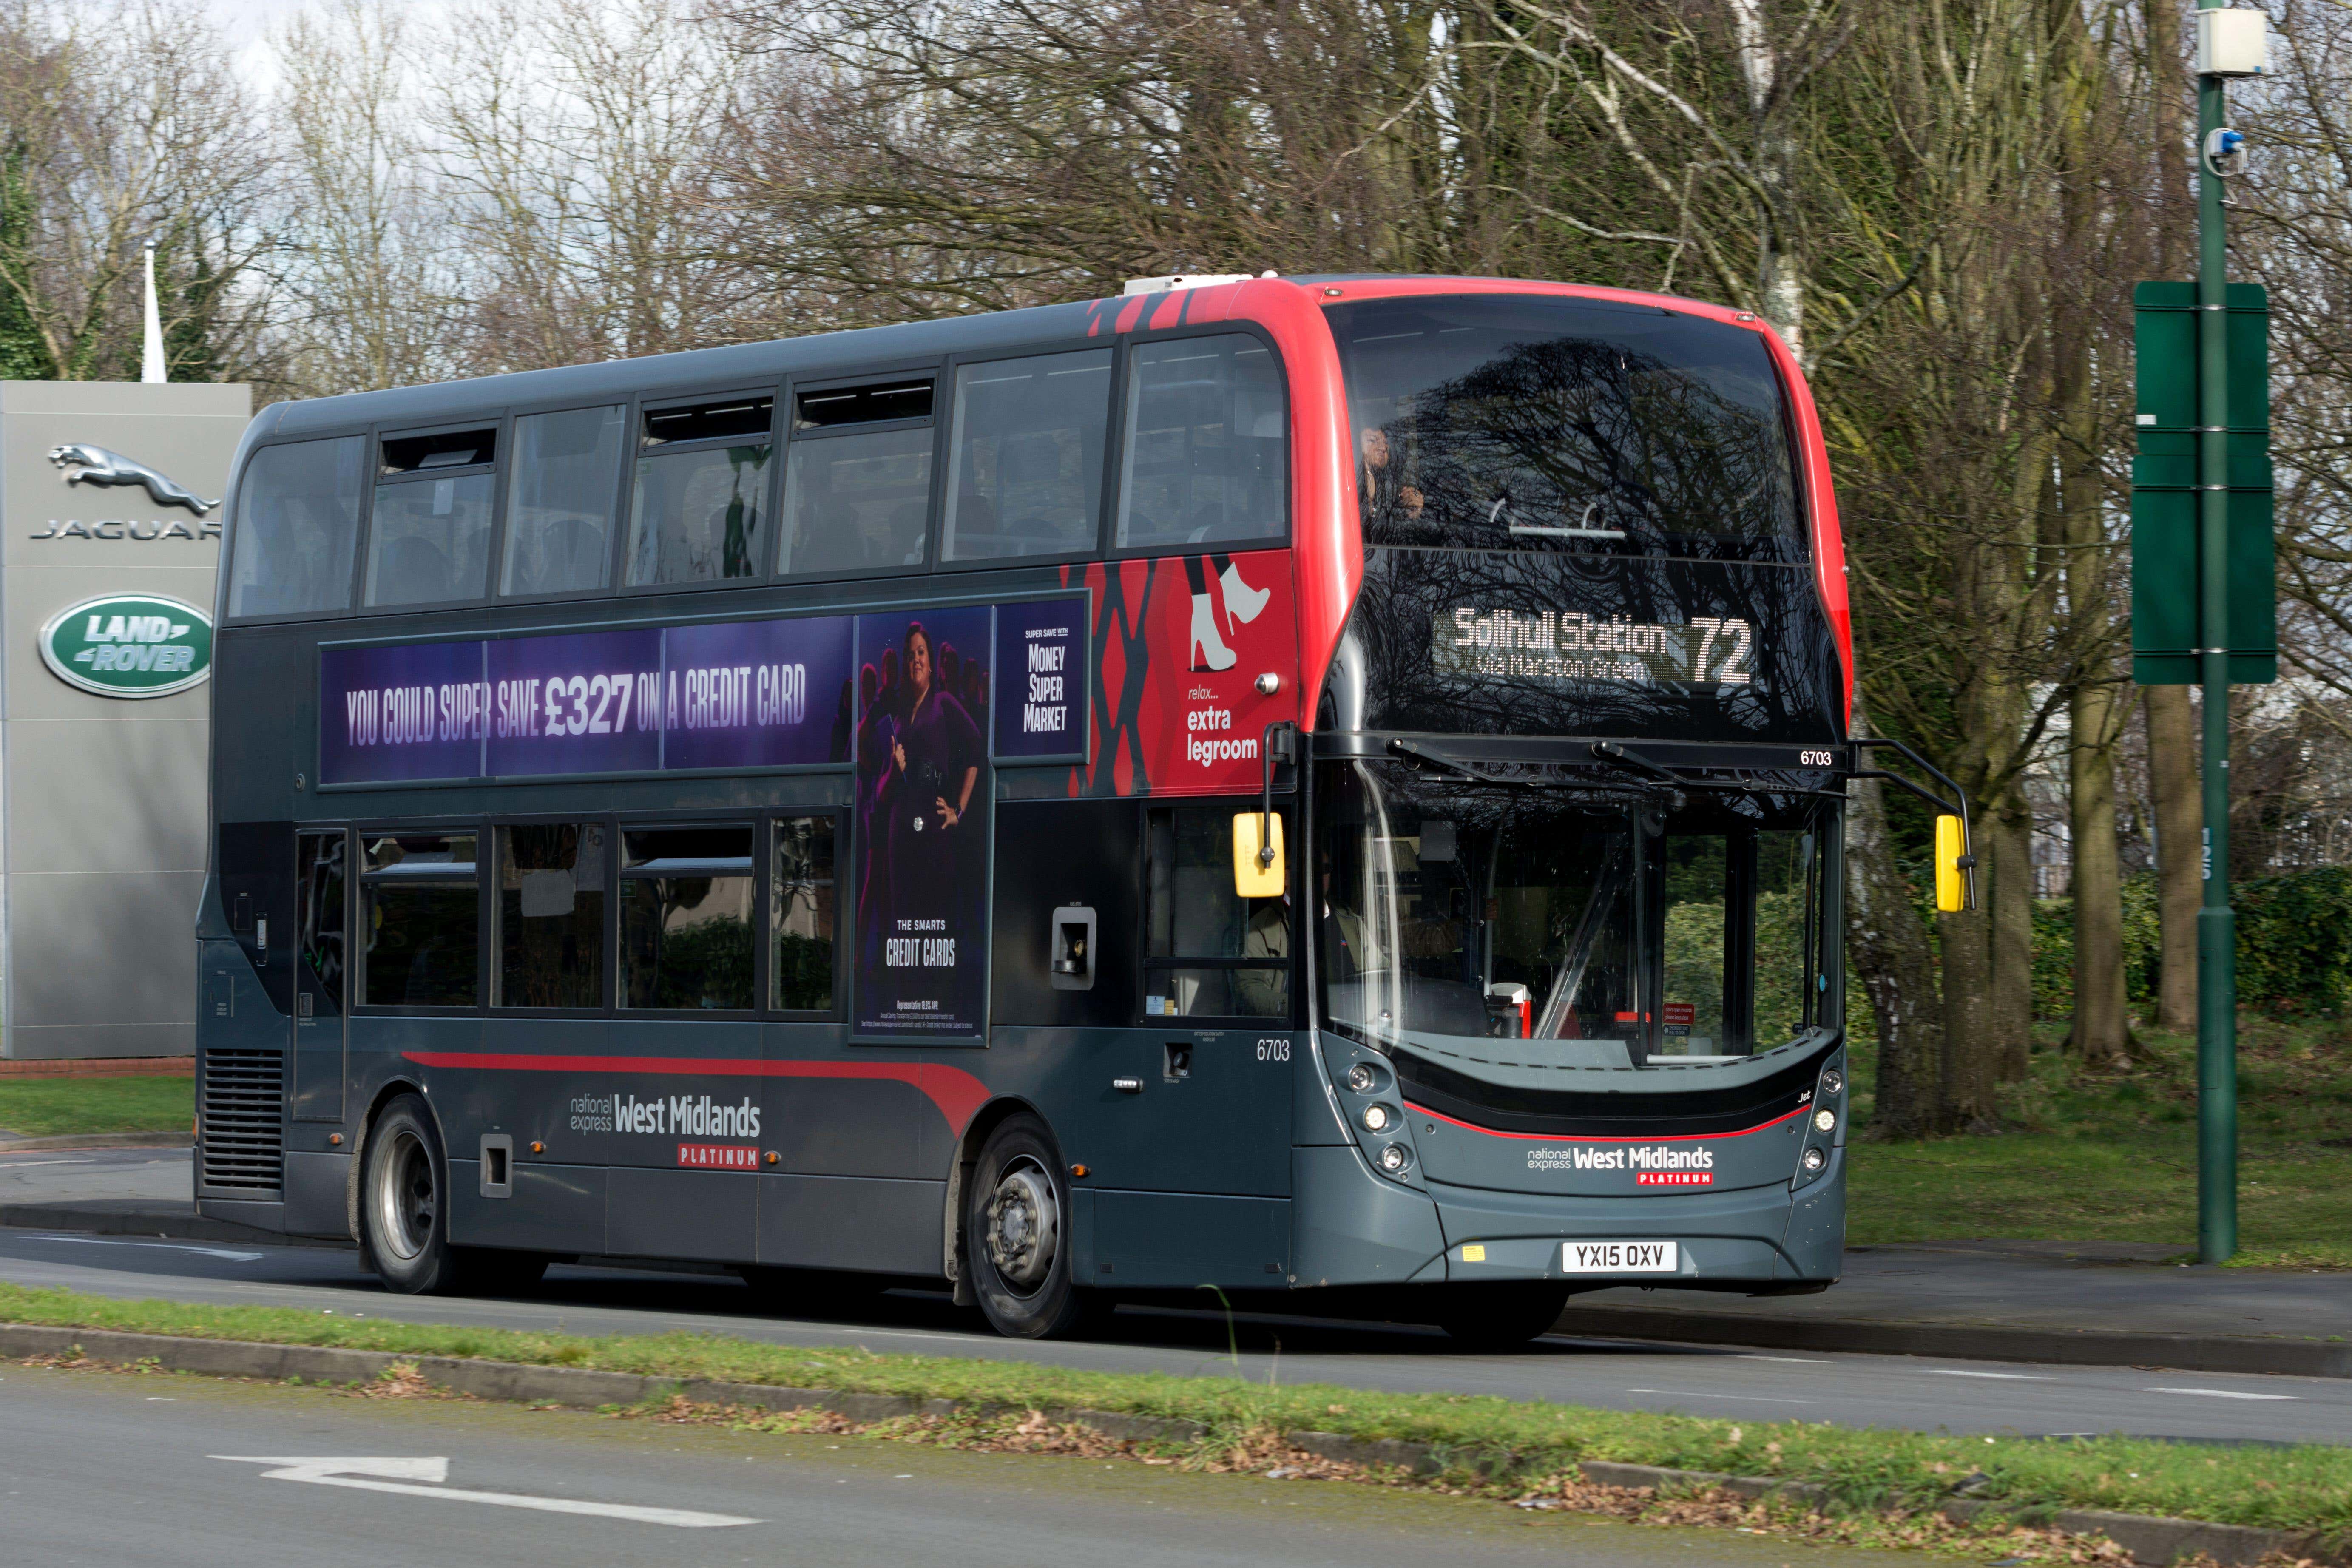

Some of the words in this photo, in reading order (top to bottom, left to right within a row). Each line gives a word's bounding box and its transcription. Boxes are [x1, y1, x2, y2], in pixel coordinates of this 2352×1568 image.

[29, 520, 221, 540] JAGUAR
[84, 615, 171, 643] LAND
[1025, 629, 1042, 638] SUPER
[1043, 628, 1057, 637] SAVE
[1455, 608, 1554, 649] Solihull
[1562, 612, 1666, 653] Station
[91, 644, 195, 671] ROVER
[1028, 644, 1065, 672] MONEY
[1691, 617, 1751, 683] 72
[1510, 654, 1585, 677] Marston
[1590, 657, 1644, 679] Green
[1029, 673, 1063, 702] SUPER
[1188, 684, 1219, 700] relax...
[347, 689, 378, 746] YOU
[383, 685, 435, 744] COULD
[440, 682, 491, 742] SUPER
[497, 679, 540, 738] SAVE
[545, 673, 633, 736] £327
[638, 671, 660, 732] ON
[667, 670, 679, 730] A
[685, 666, 751, 729] CREDIT
[757, 663, 806, 727] CARD
[1023, 704, 1067, 732] MARKET
[1187, 705, 1231, 731] extra
[1187, 733, 1257, 767] legroom
[1801, 750, 1832, 766] 6703
[897, 920, 912, 930] THE
[914, 920, 946, 931] SMARTS
[886, 938, 920, 966] CREDIT
[923, 938, 955, 967] CARDS
[1257, 1039, 1290, 1061] 6703
[571, 1093, 612, 1114] national
[1798, 1090, 1811, 1103] Jet
[571, 1115, 612, 1136] express
[614, 1094, 665, 1134] West
[670, 1095, 760, 1137] Midlands
[681, 1148, 756, 1165] PLATINUM
[1528, 1148, 1571, 1159] national
[1574, 1148, 1624, 1169] West
[1629, 1147, 1713, 1169] Midlands
[1528, 1159, 1571, 1171] express
[1639, 1173, 1710, 1184] PLATINUM
[1577, 1245, 1620, 1267] YX15
[1627, 1245, 1664, 1266] OXV
